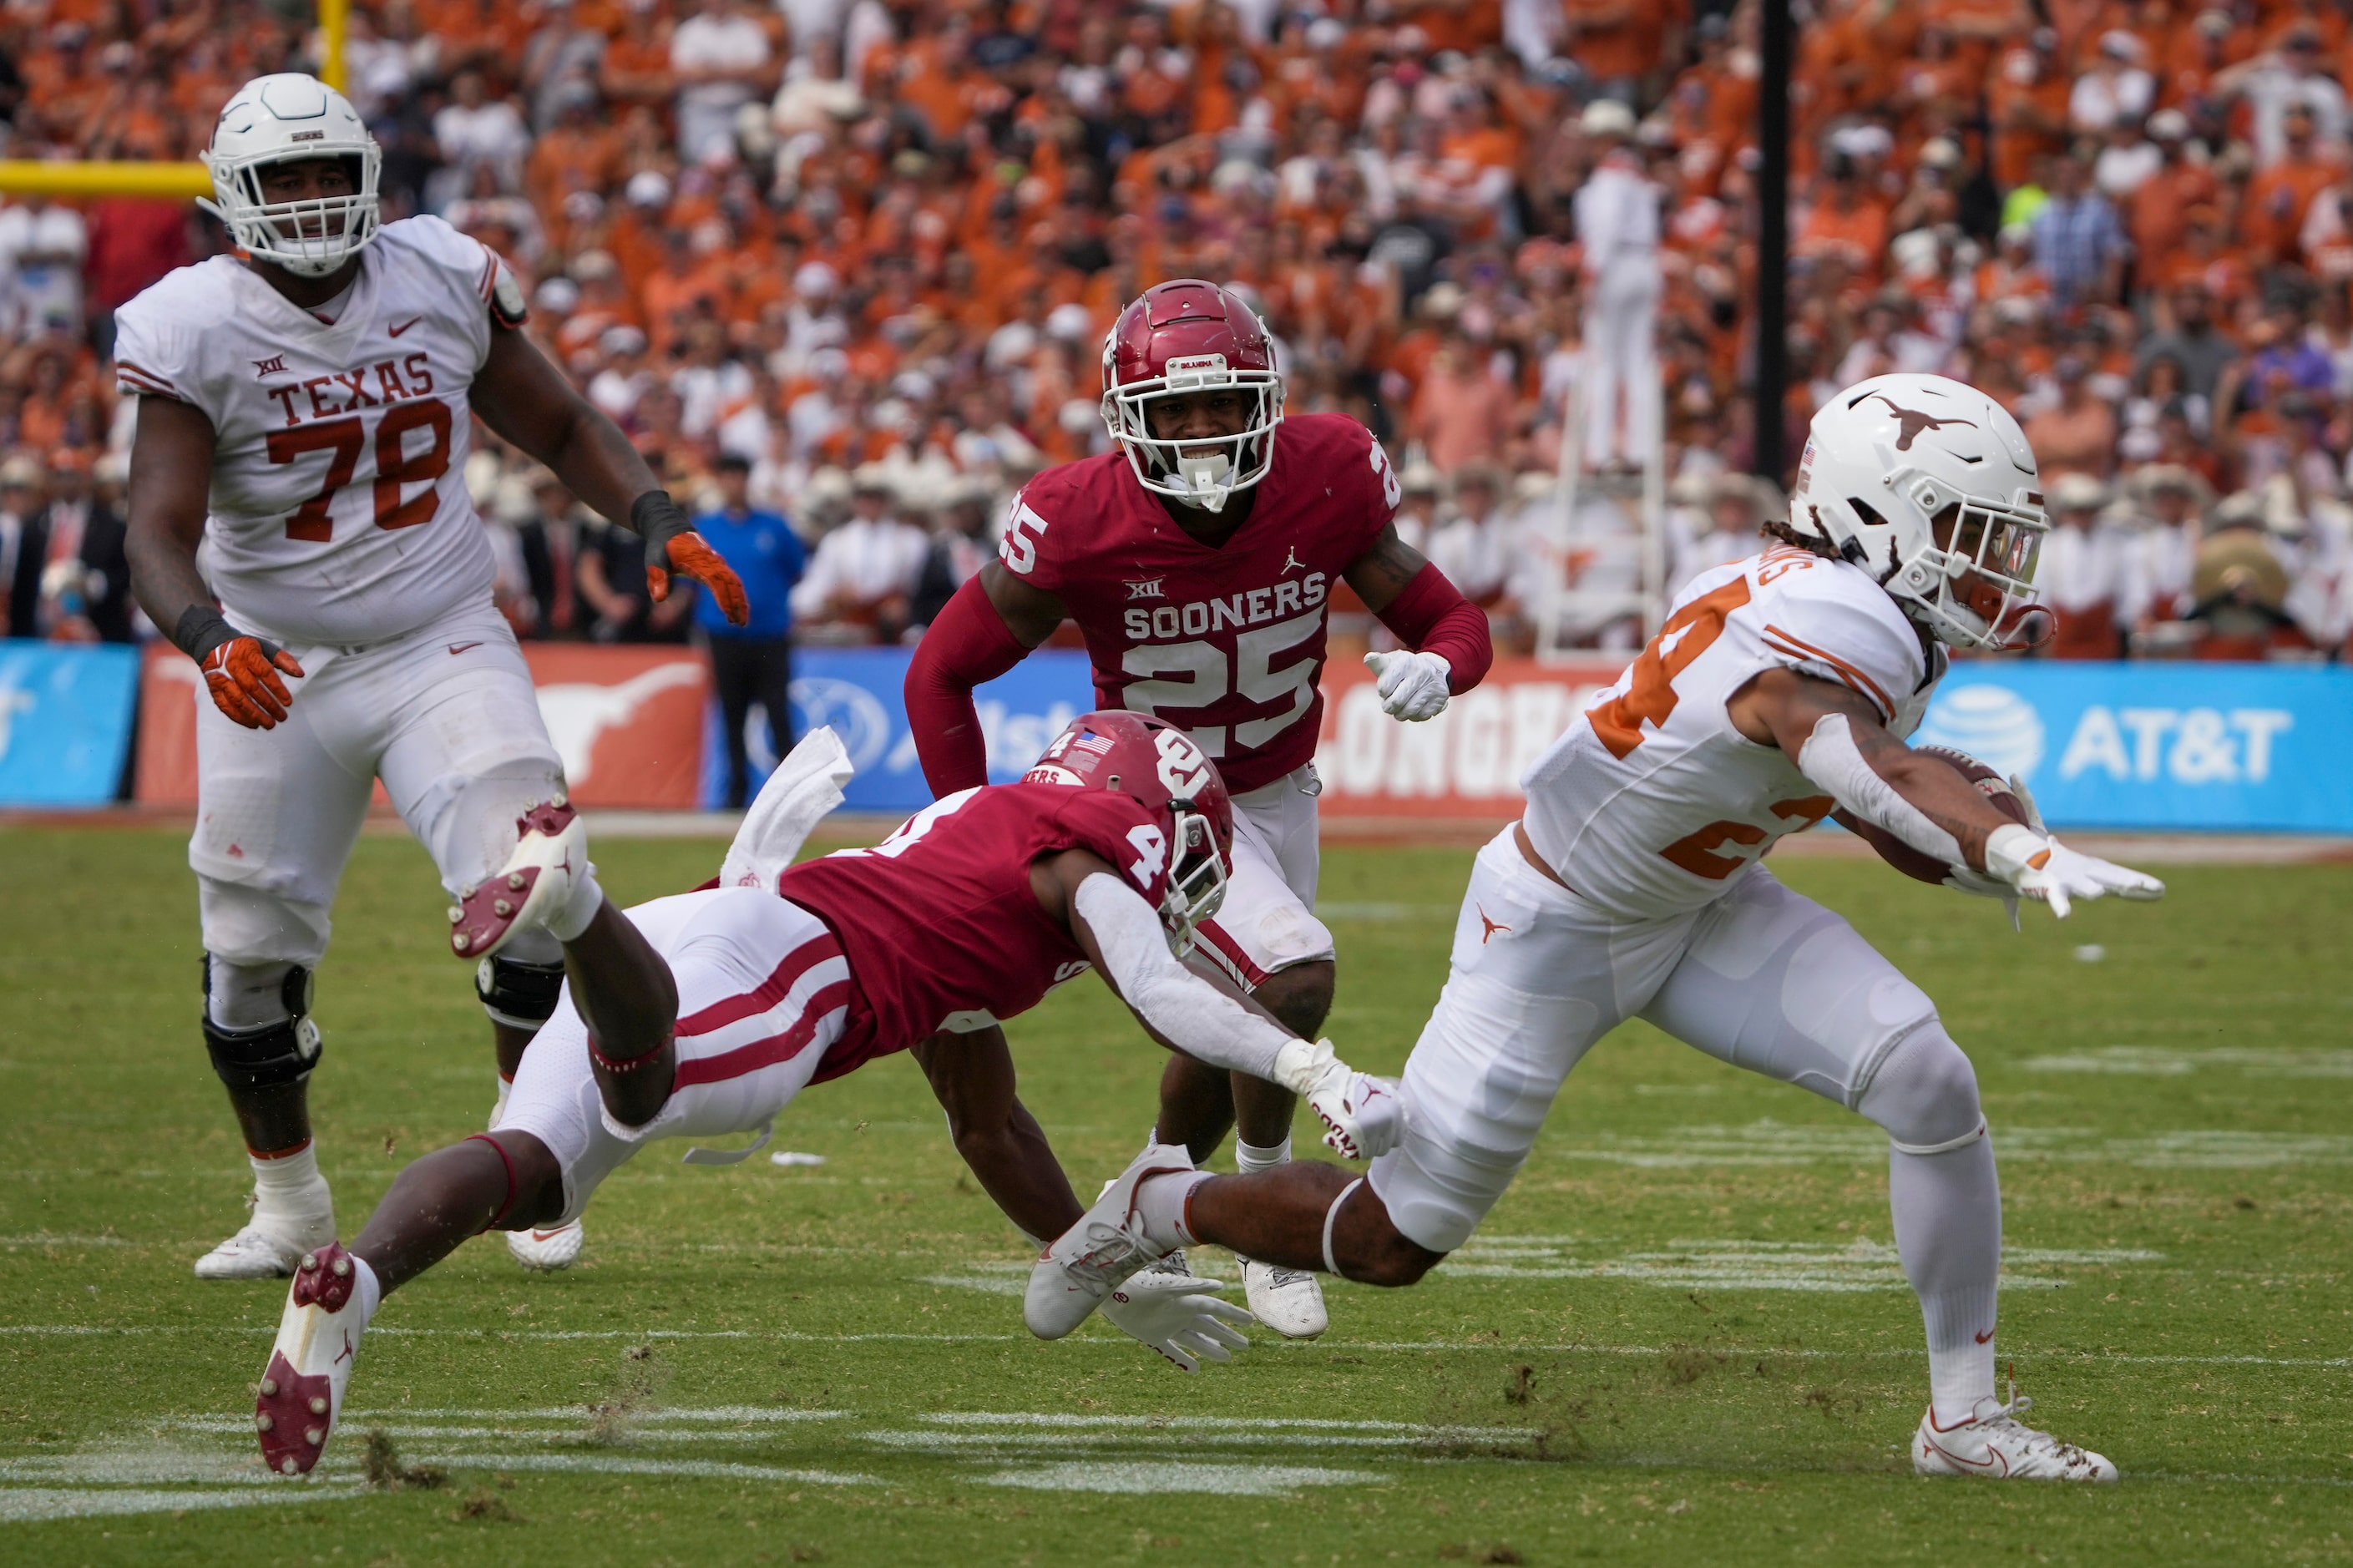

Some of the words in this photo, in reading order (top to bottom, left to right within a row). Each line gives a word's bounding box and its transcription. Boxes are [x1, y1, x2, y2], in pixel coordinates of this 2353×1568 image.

[268, 352, 433, 427] TEXAS
[1181, 360, 1213, 369] OKLAHOMA
[266, 397, 452, 543] 78
[1366, 427, 1402, 510] 2
[1124, 578, 1166, 600] XII
[1124, 571, 1326, 640] SOONERS
[1121, 600, 1328, 758] 25
[1585, 561, 1752, 761] 4
[1050, 731, 1076, 757] 4
[2057, 705, 2293, 783] AT&T
[1125, 823, 1166, 890] 4
